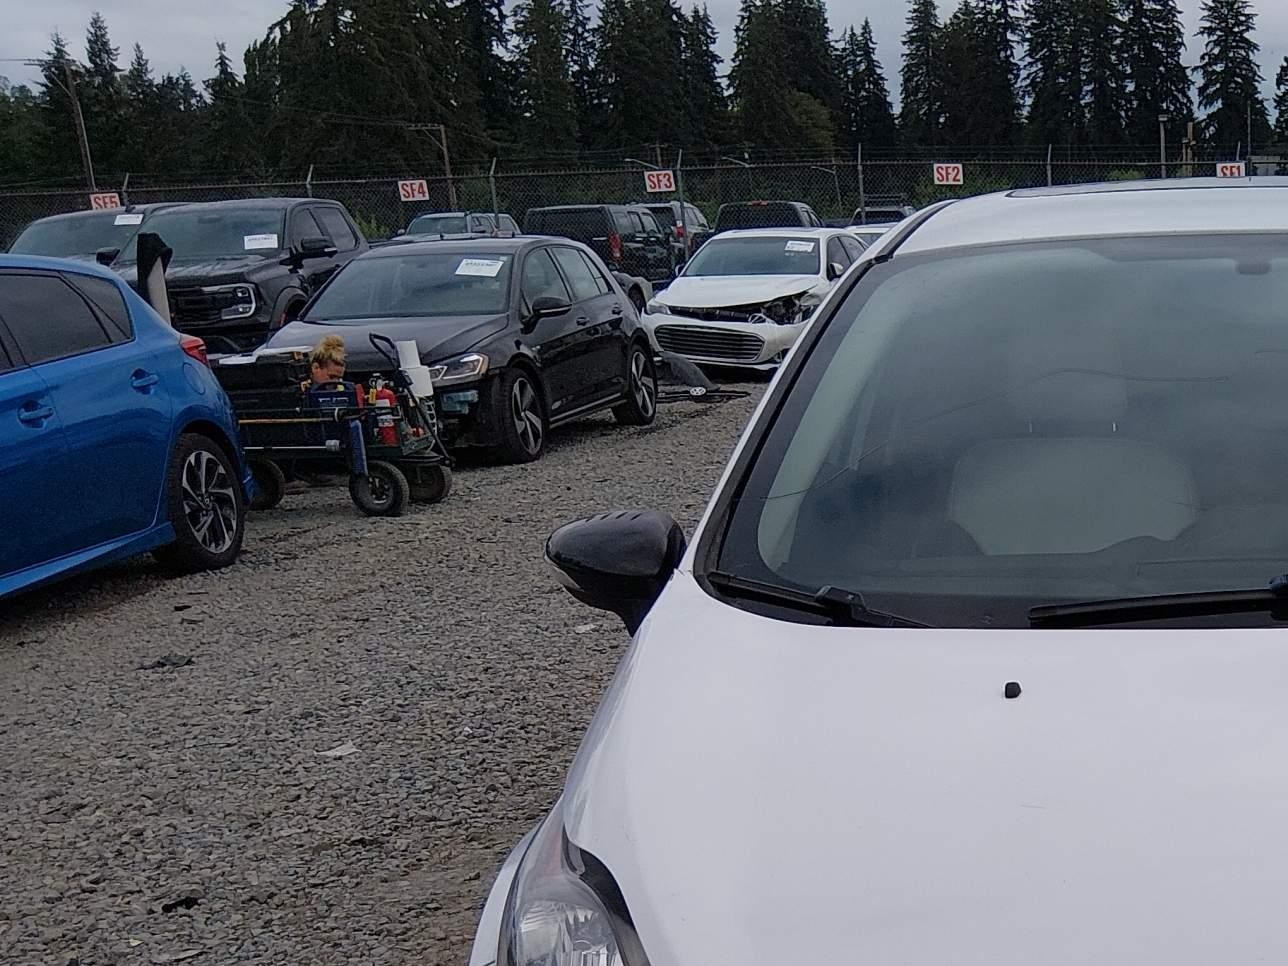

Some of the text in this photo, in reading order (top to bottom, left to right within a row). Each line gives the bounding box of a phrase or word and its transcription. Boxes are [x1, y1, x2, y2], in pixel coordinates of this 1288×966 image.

[936, 166, 961, 182] SF2
[1221, 166, 1241, 177] SF1
[647, 173, 673, 189] SF3
[401, 182, 426, 198] SF4
[94, 195, 118, 209] SF5
